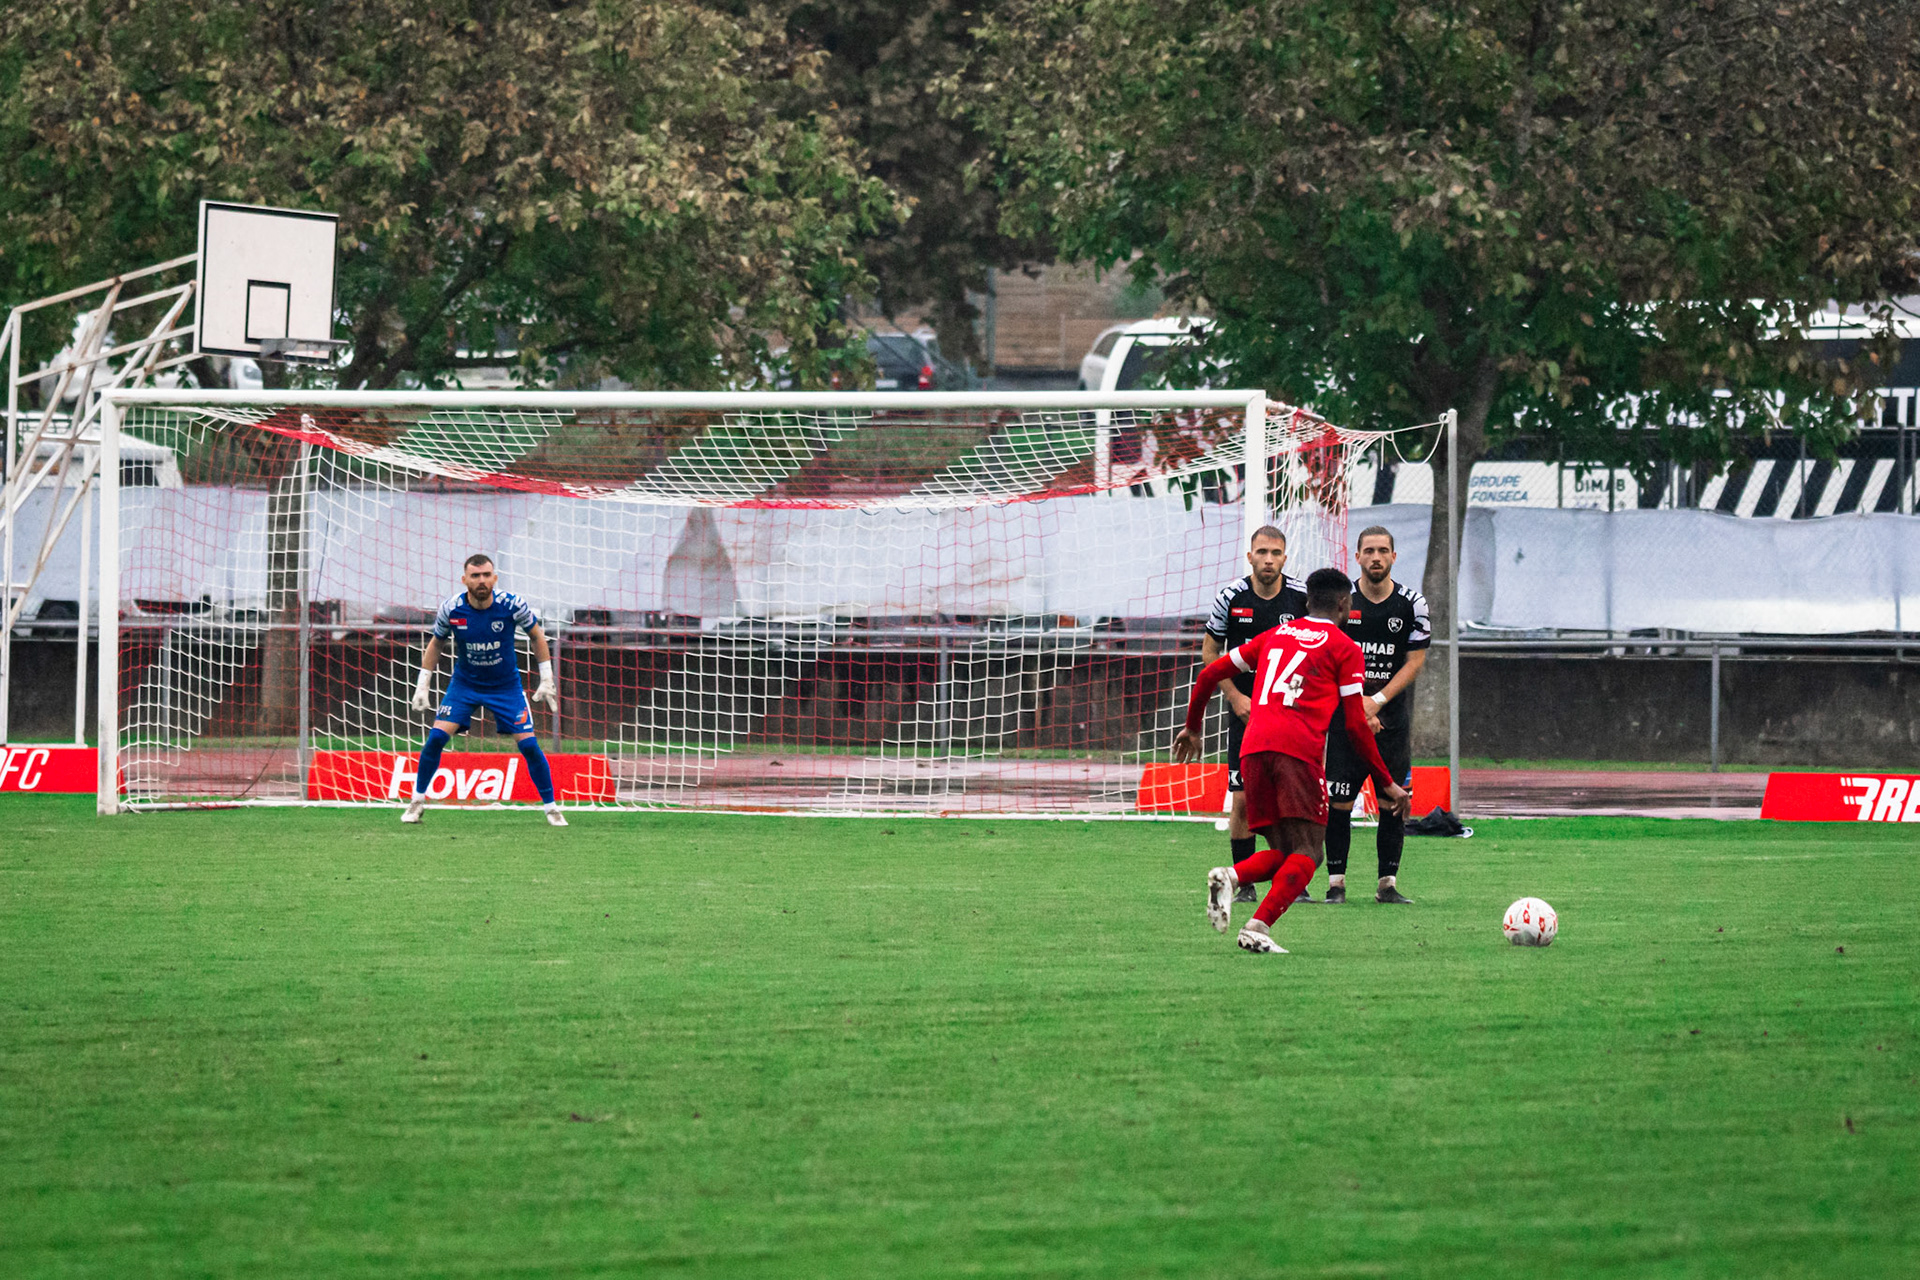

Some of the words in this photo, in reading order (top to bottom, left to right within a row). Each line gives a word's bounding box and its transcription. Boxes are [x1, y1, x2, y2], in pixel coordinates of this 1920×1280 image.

[1470, 476, 1521, 488] GROUPE
[1471, 491, 1528, 502] FONSECA
[466, 641, 501, 652] DIMAB
[1258, 648, 1308, 707] 14
[388, 756, 519, 801] Hoval
